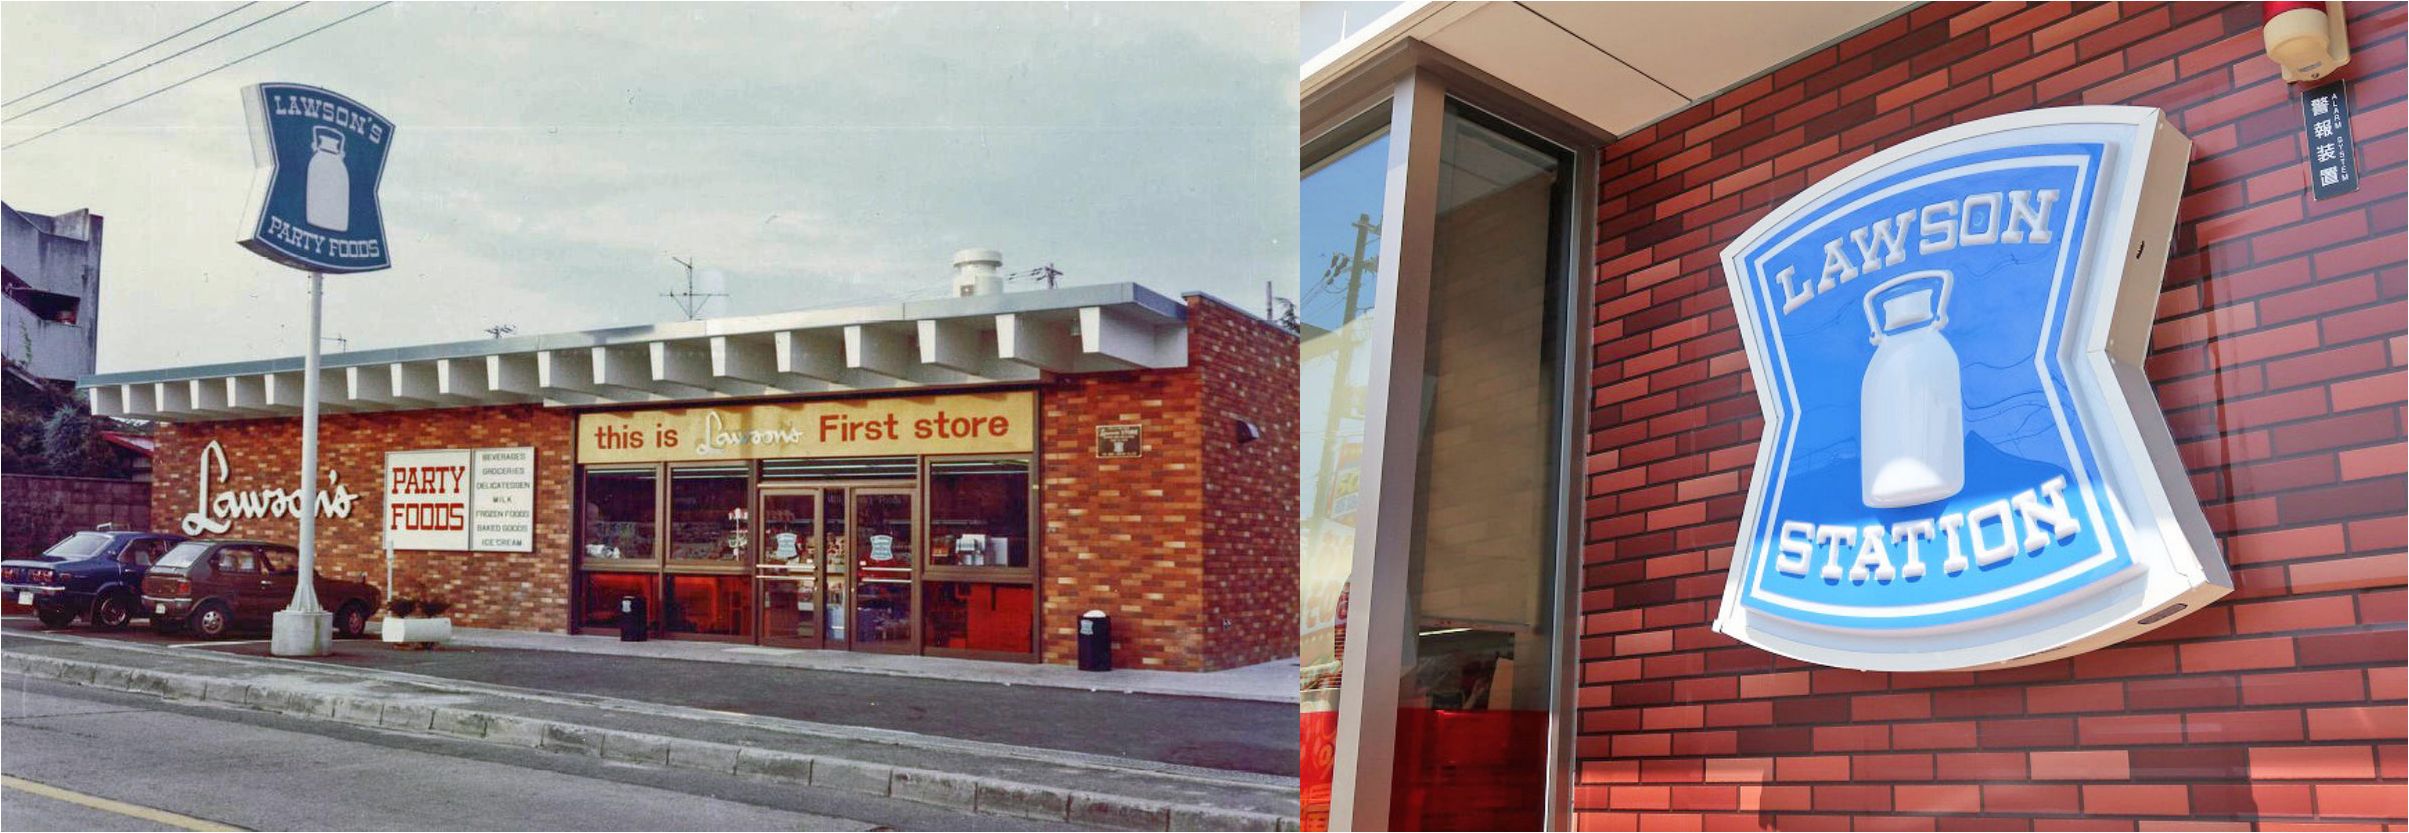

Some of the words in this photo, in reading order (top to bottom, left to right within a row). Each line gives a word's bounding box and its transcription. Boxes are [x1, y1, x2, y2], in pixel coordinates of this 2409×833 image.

[274, 95, 383, 145] LAWSON'S
[2331, 94, 2342, 129] ALARM
[2311, 96, 2339, 187] 警報装置
[2336, 137, 2349, 181] SYSTEM
[268, 215, 326, 254] PARTY
[328, 239, 380, 258] FOODS
[1774, 189, 2061, 316] LAWSON
[594, 424, 644, 450] this
[656, 423, 679, 449] is
[819, 413, 899, 443] First
[914, 411, 1009, 440] store
[391, 466, 465, 494] PARTY
[482, 467, 525, 475] GROCERIES
[391, 503, 464, 531] FOODS
[1775, 475, 2081, 582] STATION
